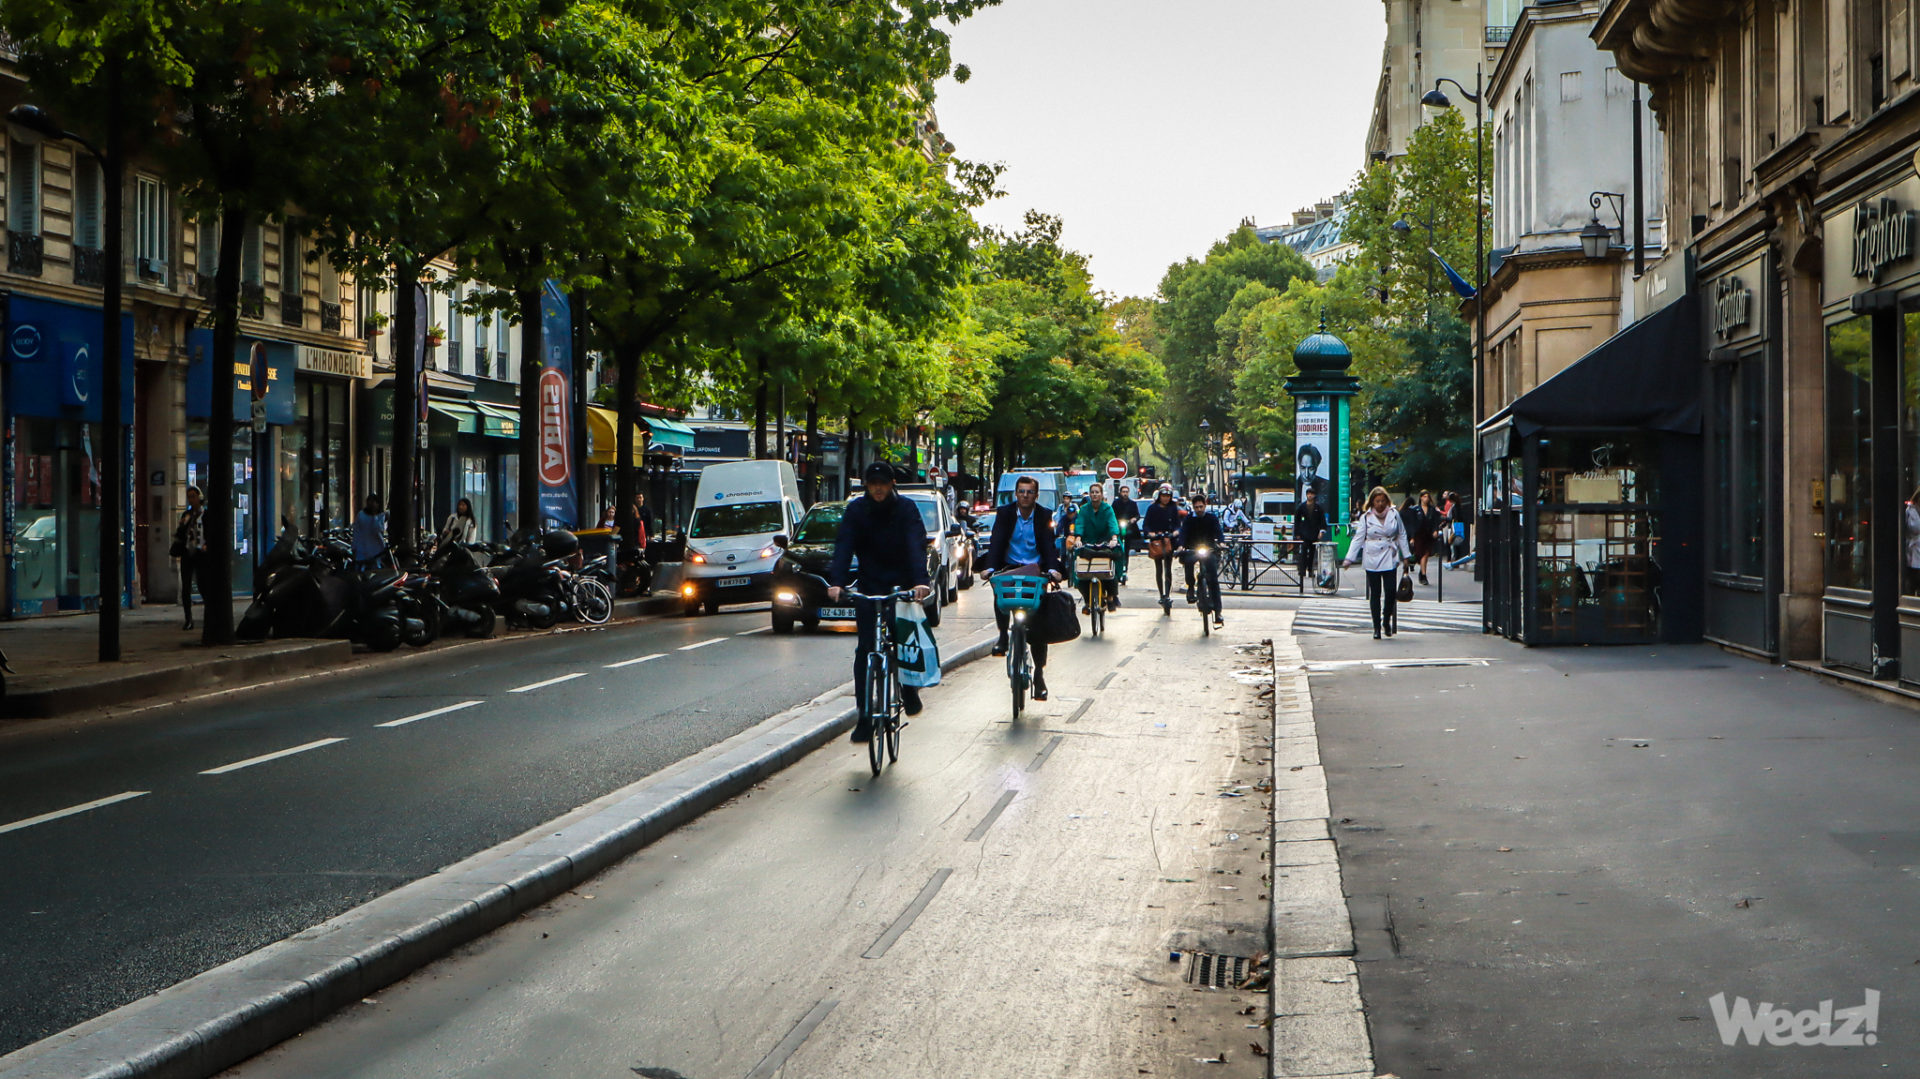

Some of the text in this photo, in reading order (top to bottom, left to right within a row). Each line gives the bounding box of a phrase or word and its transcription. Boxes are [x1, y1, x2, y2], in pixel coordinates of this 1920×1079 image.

[1852, 200, 1908, 283] Brighton
[1713, 277, 1747, 340] Brighton
[305, 348, 366, 377] L'HIRONDELLE
